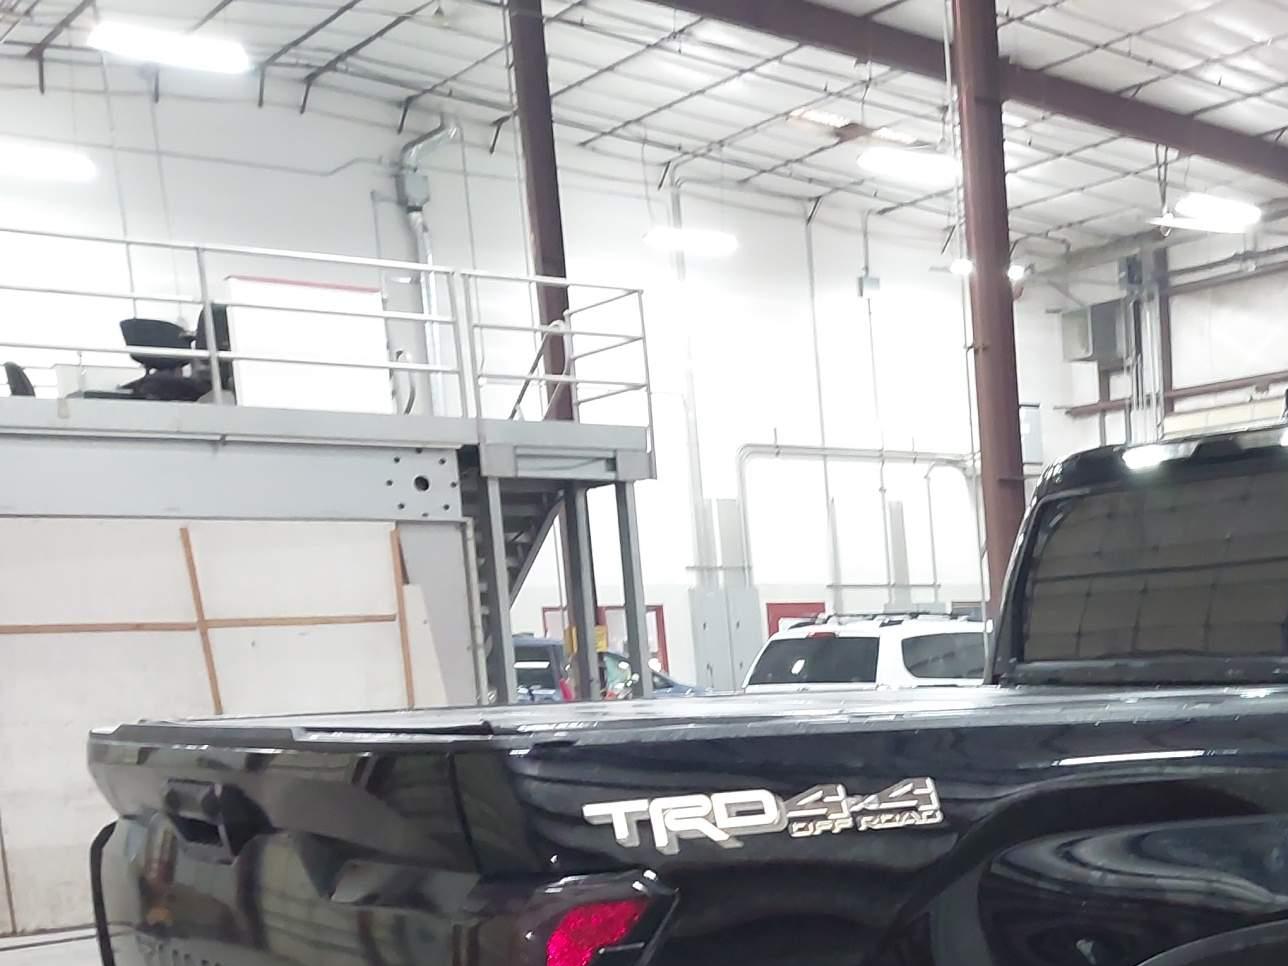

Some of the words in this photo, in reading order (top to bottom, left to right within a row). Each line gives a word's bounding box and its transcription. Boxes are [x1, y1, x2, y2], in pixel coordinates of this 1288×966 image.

[582, 787, 787, 855] TRD
[788, 818, 853, 838] OFF
[857, 810, 944, 831] ROAD
